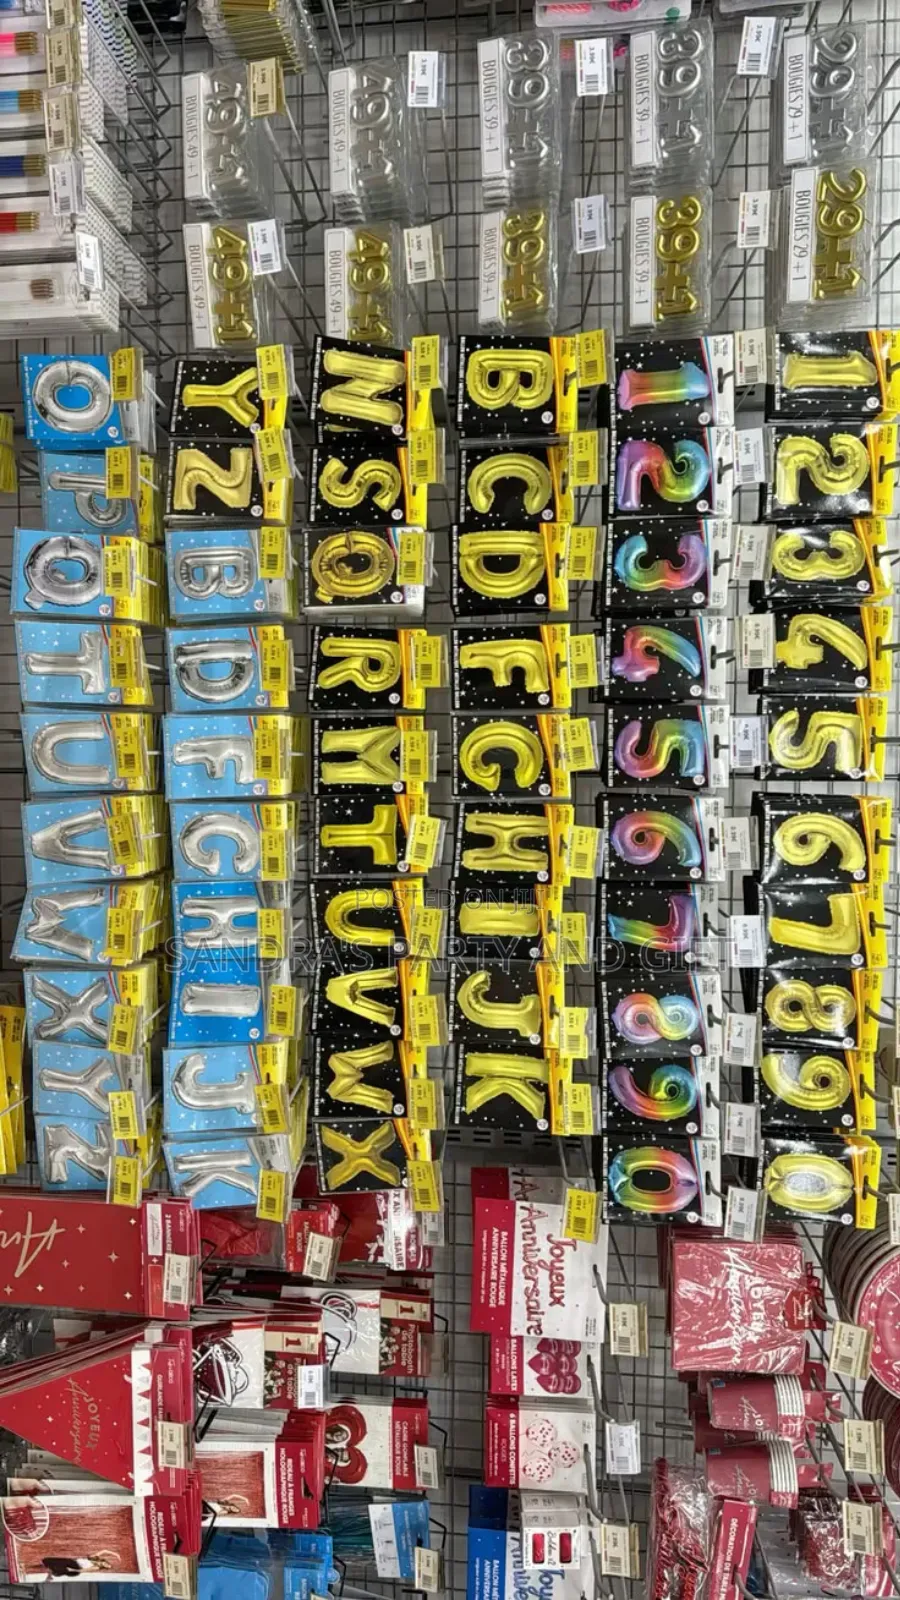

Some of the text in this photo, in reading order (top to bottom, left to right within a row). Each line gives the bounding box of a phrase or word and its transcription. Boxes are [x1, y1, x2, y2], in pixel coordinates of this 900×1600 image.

[482, 60, 497, 112] BOUGIES
[635, 54, 650, 105] BOUGIES
[788, 54, 803, 103] BOUGIES
[332, 89, 345, 136] BOUGIES
[484, 115, 498, 129] 39
[635, 107, 649, 121] 39
[788, 105, 803, 118] 29
[334, 138, 346, 152] 49
[635, 218, 650, 268] BOUGIES
[794, 190, 811, 241] BOUGIES
[329, 250, 342, 297] BOUGIES
[635, 269, 649, 282] 39
[794, 243, 809, 258] 29
[330, 299, 342, 313] 49
[182, 367, 260, 428] Y
[320, 352, 406, 426] N
[466, 349, 553, 410] B
[618, 362, 710, 410] 1
[782, 353, 877, 389] 1
[174, 448, 252, 510] Z
[319, 458, 401, 511] S
[468, 453, 551, 514] C
[617, 440, 711, 510] 2
[776, 434, 869, 504] 2
[50, 472, 127, 528] P
[24, 536, 103, 610] Q
[174, 547, 256, 598] B
[312, 531, 395, 604] Q
[459, 530, 544, 598] D
[614, 534, 707, 591] 3
[772, 530, 865, 580] 3
[26, 632, 105, 694] T
[318, 637, 400, 692] R
[459, 639, 549, 693] F
[611, 625, 700, 682] 4
[776, 614, 867, 670] 4
[174, 640, 254, 703] D
[32, 721, 110, 784] U
[173, 736, 254, 784] F
[321, 726, 400, 785] M
[459, 722, 544, 791] G
[615, 720, 704, 778] 5
[769, 711, 862, 772] 5
[32, 810, 110, 868] V
[179, 813, 259, 876] G
[320, 805, 397, 865] T
[462, 814, 549, 872] H
[610, 811, 701, 867] 6
[773, 814, 866, 872] 6
[25, 887, 106, 960] W
[181, 896, 259, 949] H
[324, 889, 395, 947] U
[608, 895, 696, 952] 7
[768, 893, 861, 954] 7
[33, 976, 110, 1048] X
[326, 968, 398, 1026] V
[457, 970, 541, 1037] J
[611, 993, 699, 1044] 8
[765, 980, 855, 1032] 8
[39, 1058, 114, 1113] Y
[172, 1054, 255, 1114] J
[326, 1040, 393, 1113] W
[465, 1053, 549, 1120] K
[609, 1065, 697, 1120] 9
[762, 1054, 851, 1111] 9
[44, 1122, 110, 1183] Z
[175, 1152, 258, 1198] K
[322, 1121, 400, 1190] X
[609, 1146, 698, 1214] 0
[489, 1228, 498, 1308] ANNIVERSAIRE ROUGE
[498, 1231, 508, 1306] BALLON MÉTALLIQUE
[519, 1204, 548, 1336] Anniversaire
[538, 1234, 577, 1308] Joyeux
[400, 1305, 415, 1314] 1
[402, 1331, 407, 1341] de
[286, 1338, 301, 1347] 1
[407, 1324, 415, 1374] Photobooth
[66, 1378, 87, 1464] Anniversaire
[84, 1396, 100, 1449] JOYEUX
[722, 1518, 739, 1593] DÉCORATION DE TABLE
